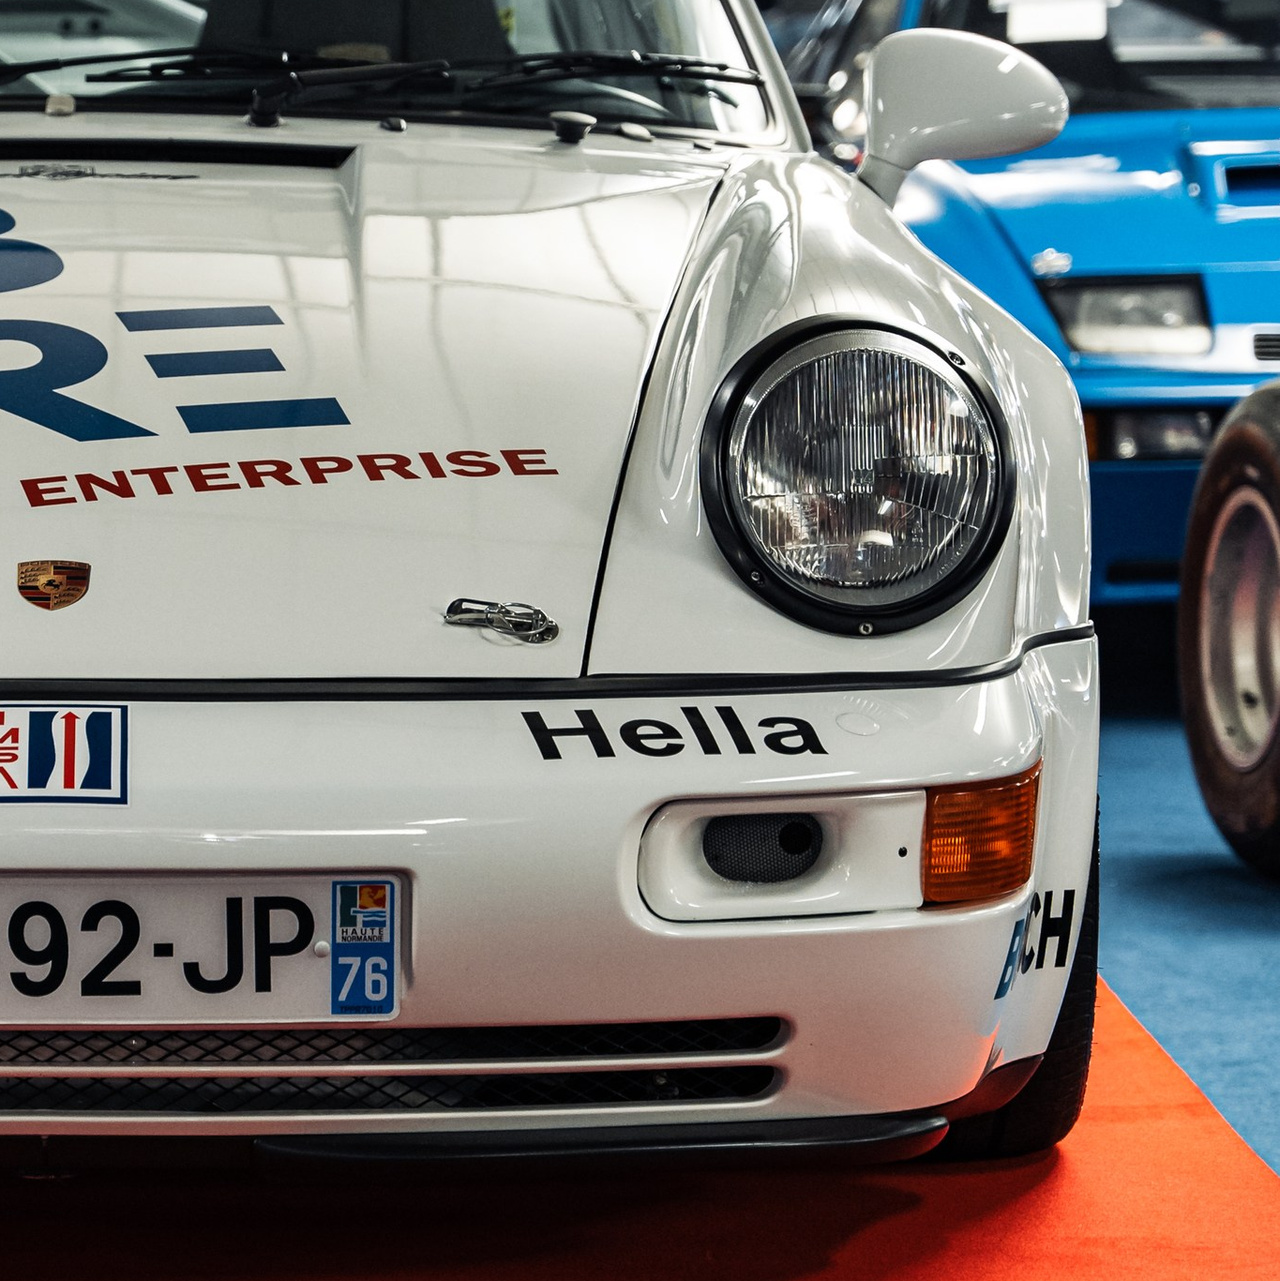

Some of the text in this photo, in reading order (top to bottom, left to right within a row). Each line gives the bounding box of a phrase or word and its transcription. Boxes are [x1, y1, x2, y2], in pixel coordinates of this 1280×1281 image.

[19, 448, 559, 508] ENTERPRISE
[520, 705, 829, 760] Hella
[341, 928, 384, 936] HAUTE
[341, 935, 384, 943] NORMANDIE
[337, 956, 388, 1001] 76
